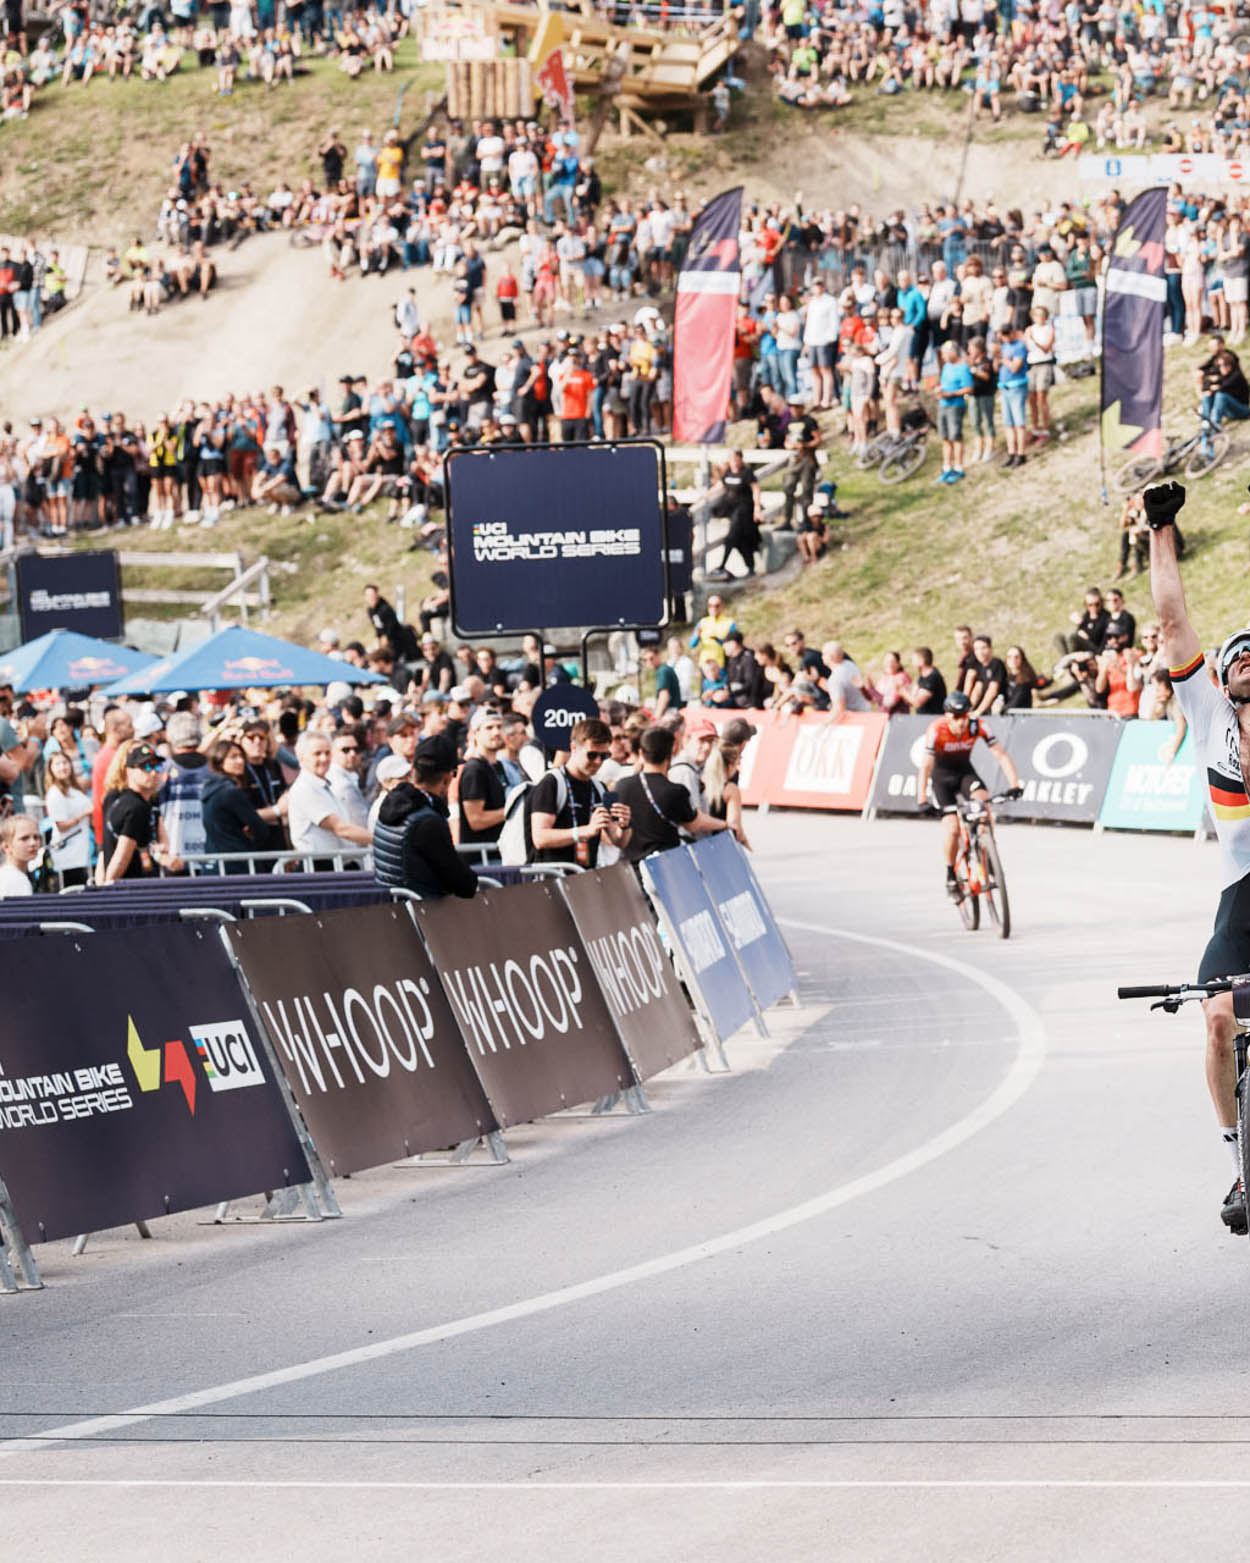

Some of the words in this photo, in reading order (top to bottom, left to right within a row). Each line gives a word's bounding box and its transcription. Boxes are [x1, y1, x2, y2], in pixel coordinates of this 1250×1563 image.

[473, 531, 586, 549] MOUNTAIN
[589, 528, 640, 543] BIKE
[479, 522, 507, 536] UCI
[474, 545, 558, 562] WORLD
[561, 541, 641, 558] SERIES
[543, 708, 587, 728] 20m
[1019, 778, 1095, 805] AKLEY
[585, 922, 669, 1017] WHOOP
[443, 948, 584, 1056] WHOOP
[262, 978, 436, 1096] WHOOP
[203, 1032, 256, 1078] UCI
[0, 1072, 75, 1103] OUNTAIN
[73, 1062, 125, 1092] BIKE
[58, 1087, 134, 1121] SERIES
